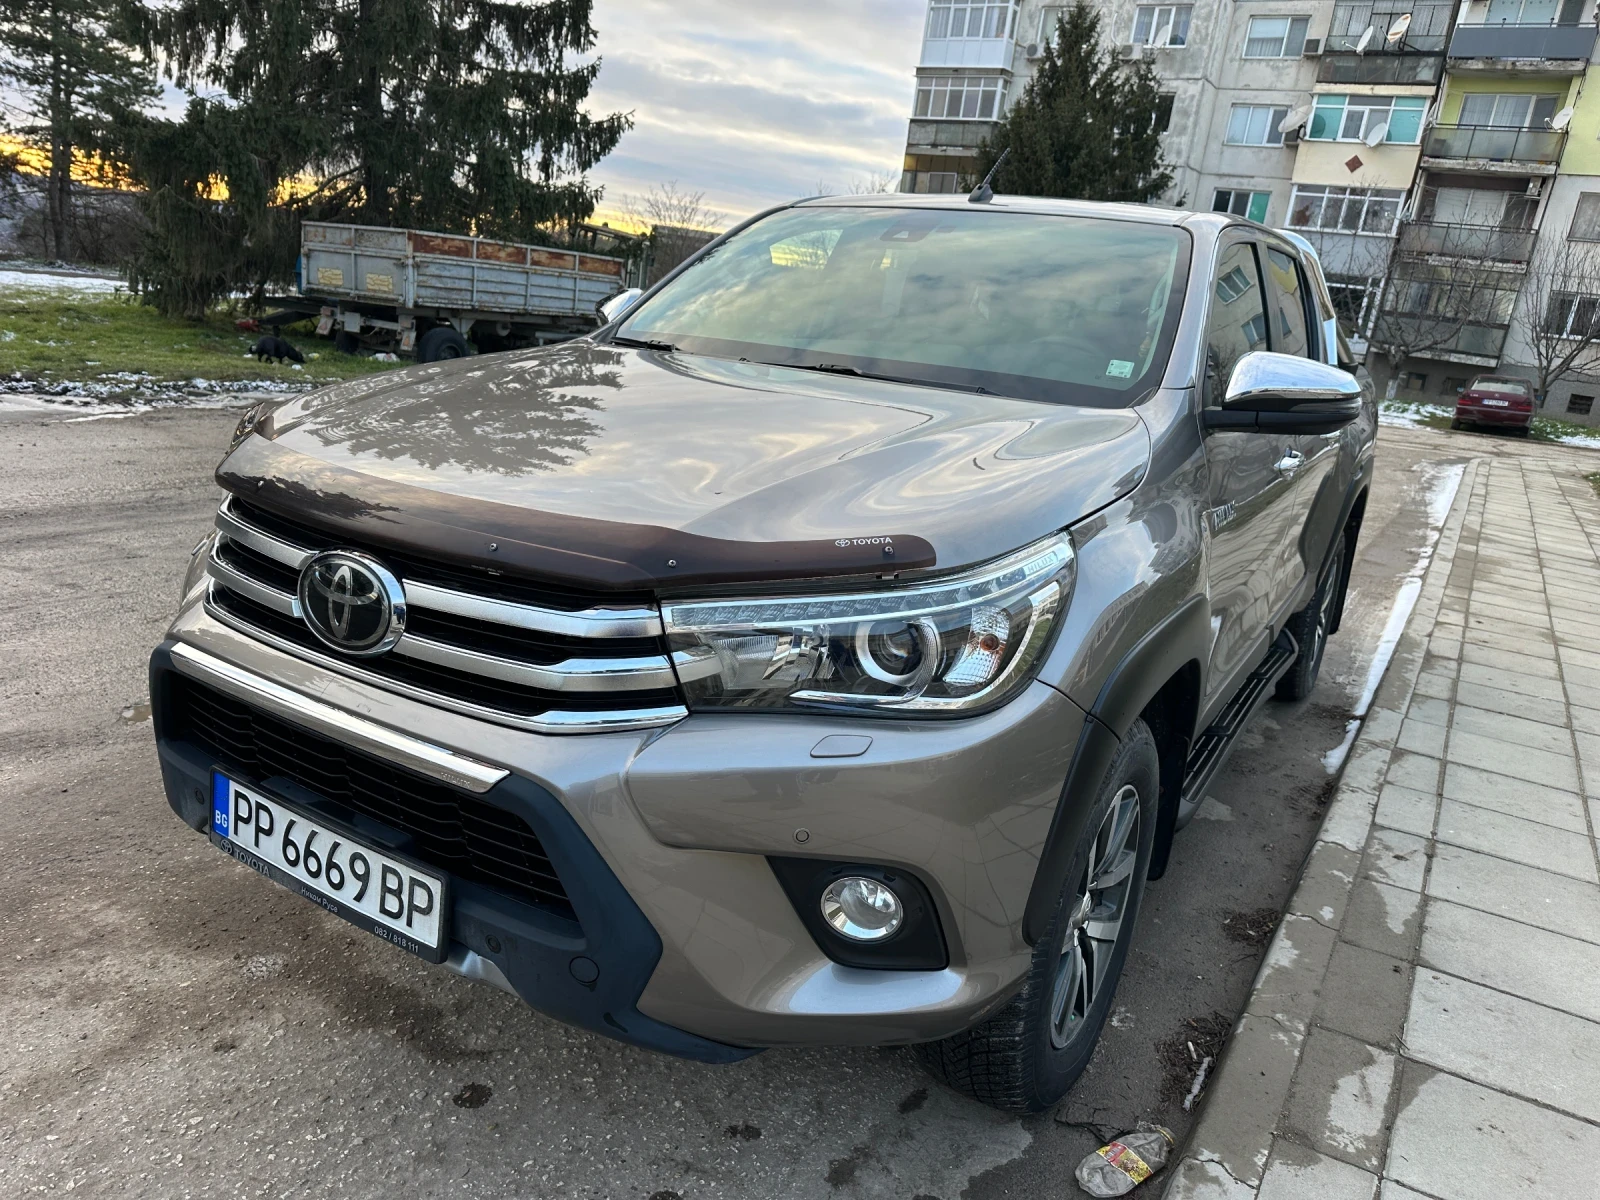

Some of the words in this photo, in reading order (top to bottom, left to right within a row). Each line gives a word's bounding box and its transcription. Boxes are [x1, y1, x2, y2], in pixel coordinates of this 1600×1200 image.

[852, 537, 892, 545] TOYOTA
[1027, 555, 1054, 573] HILUX
[215, 810, 228, 828] BG
[233, 789, 274, 849] PP
[281, 818, 371, 902] 6669
[379, 861, 434, 928] BP
[235, 849, 270, 877] TOYOTA
[322, 898, 338, 913] Русе
[374, 926, 388, 938] 082
[393, 934, 407, 947] 818
[408, 942, 418, 953] 111
